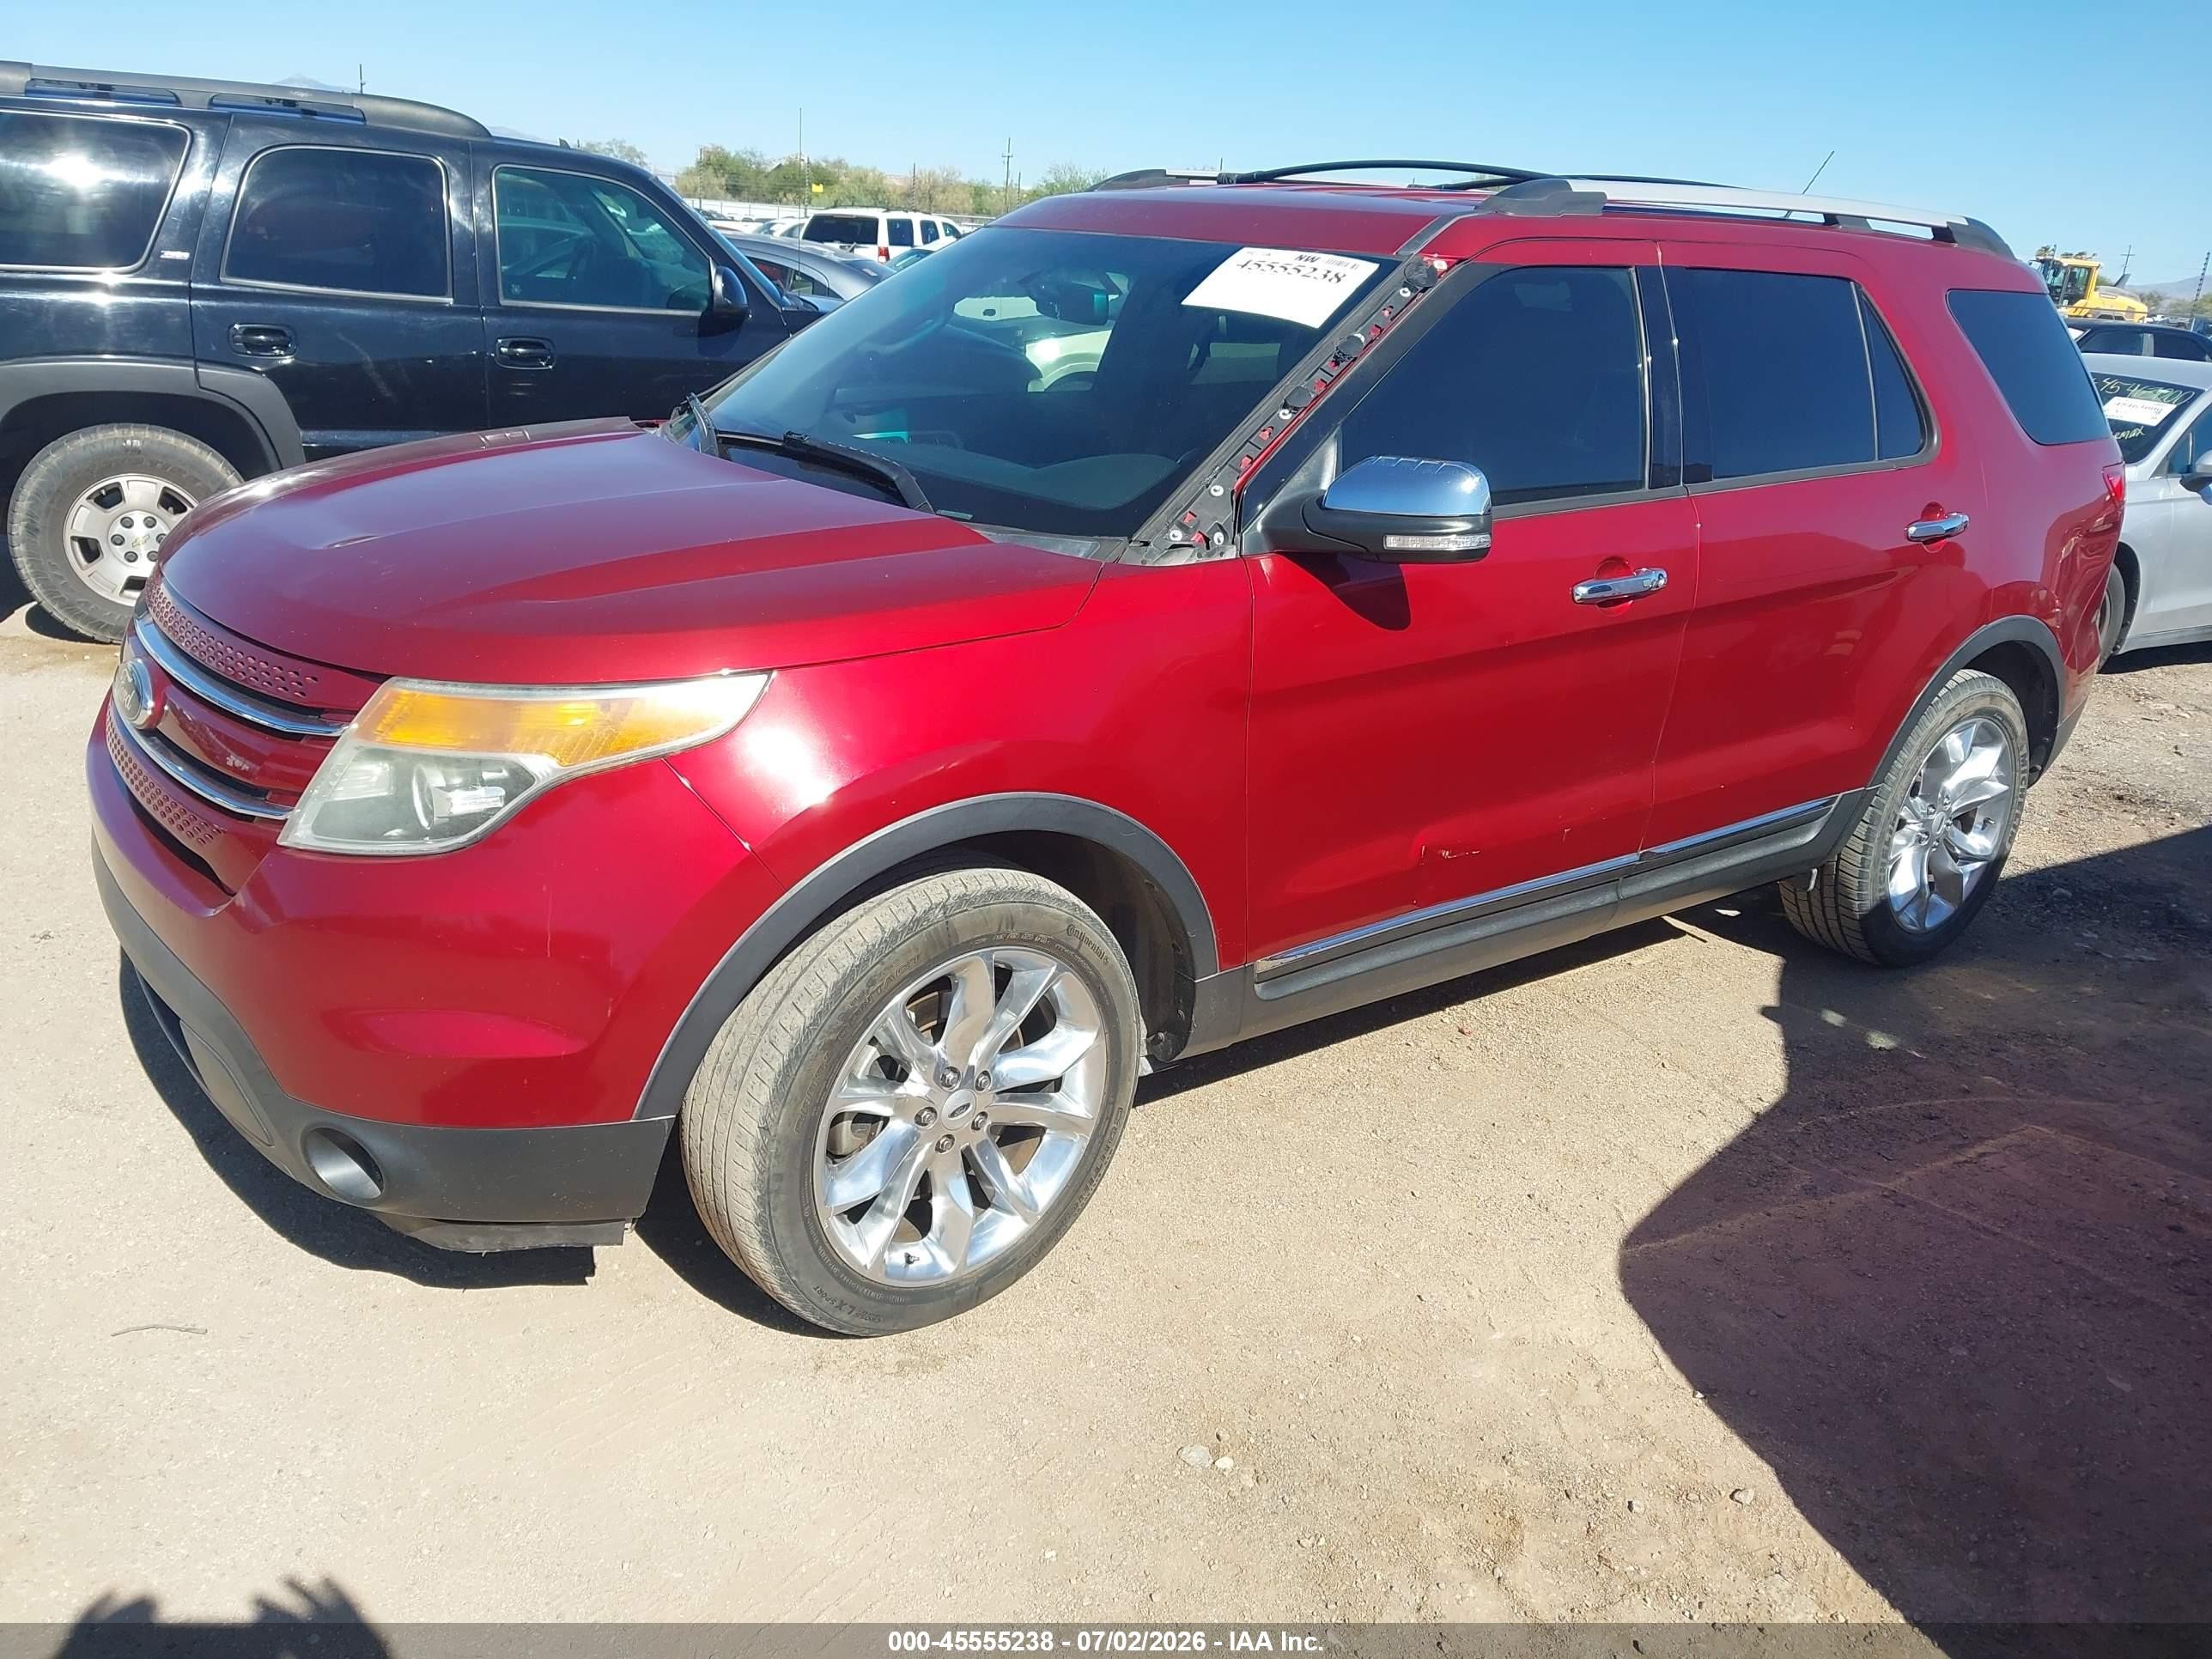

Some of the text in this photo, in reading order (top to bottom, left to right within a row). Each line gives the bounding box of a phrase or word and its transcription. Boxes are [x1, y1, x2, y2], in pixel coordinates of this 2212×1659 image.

[1294, 254, 1321, 263] NW
[1237, 259, 1346, 283] 45555238
[1066, 923, 1106, 963] Continental
[812, 1284, 838, 1306] SPORT
